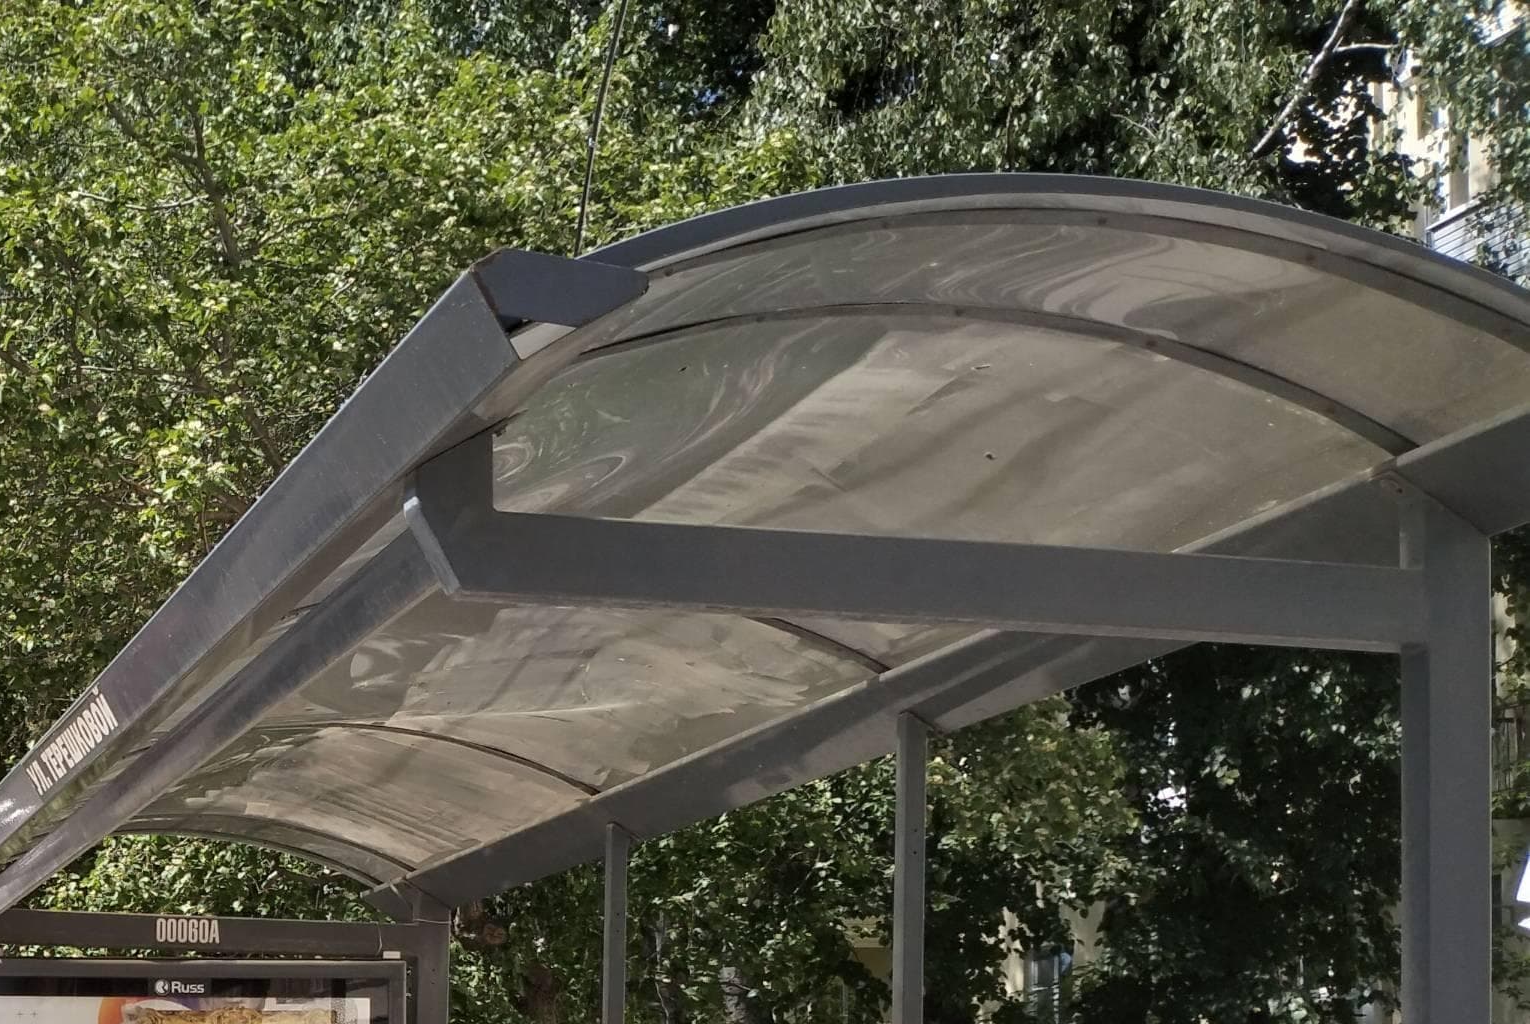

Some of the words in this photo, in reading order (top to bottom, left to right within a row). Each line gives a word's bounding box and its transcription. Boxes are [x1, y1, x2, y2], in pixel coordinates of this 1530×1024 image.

[26, 760, 53, 796] УЛ.
[41, 682, 118, 782] ТЕРЕШКОВОЙ
[171, 981, 205, 993] Russ
